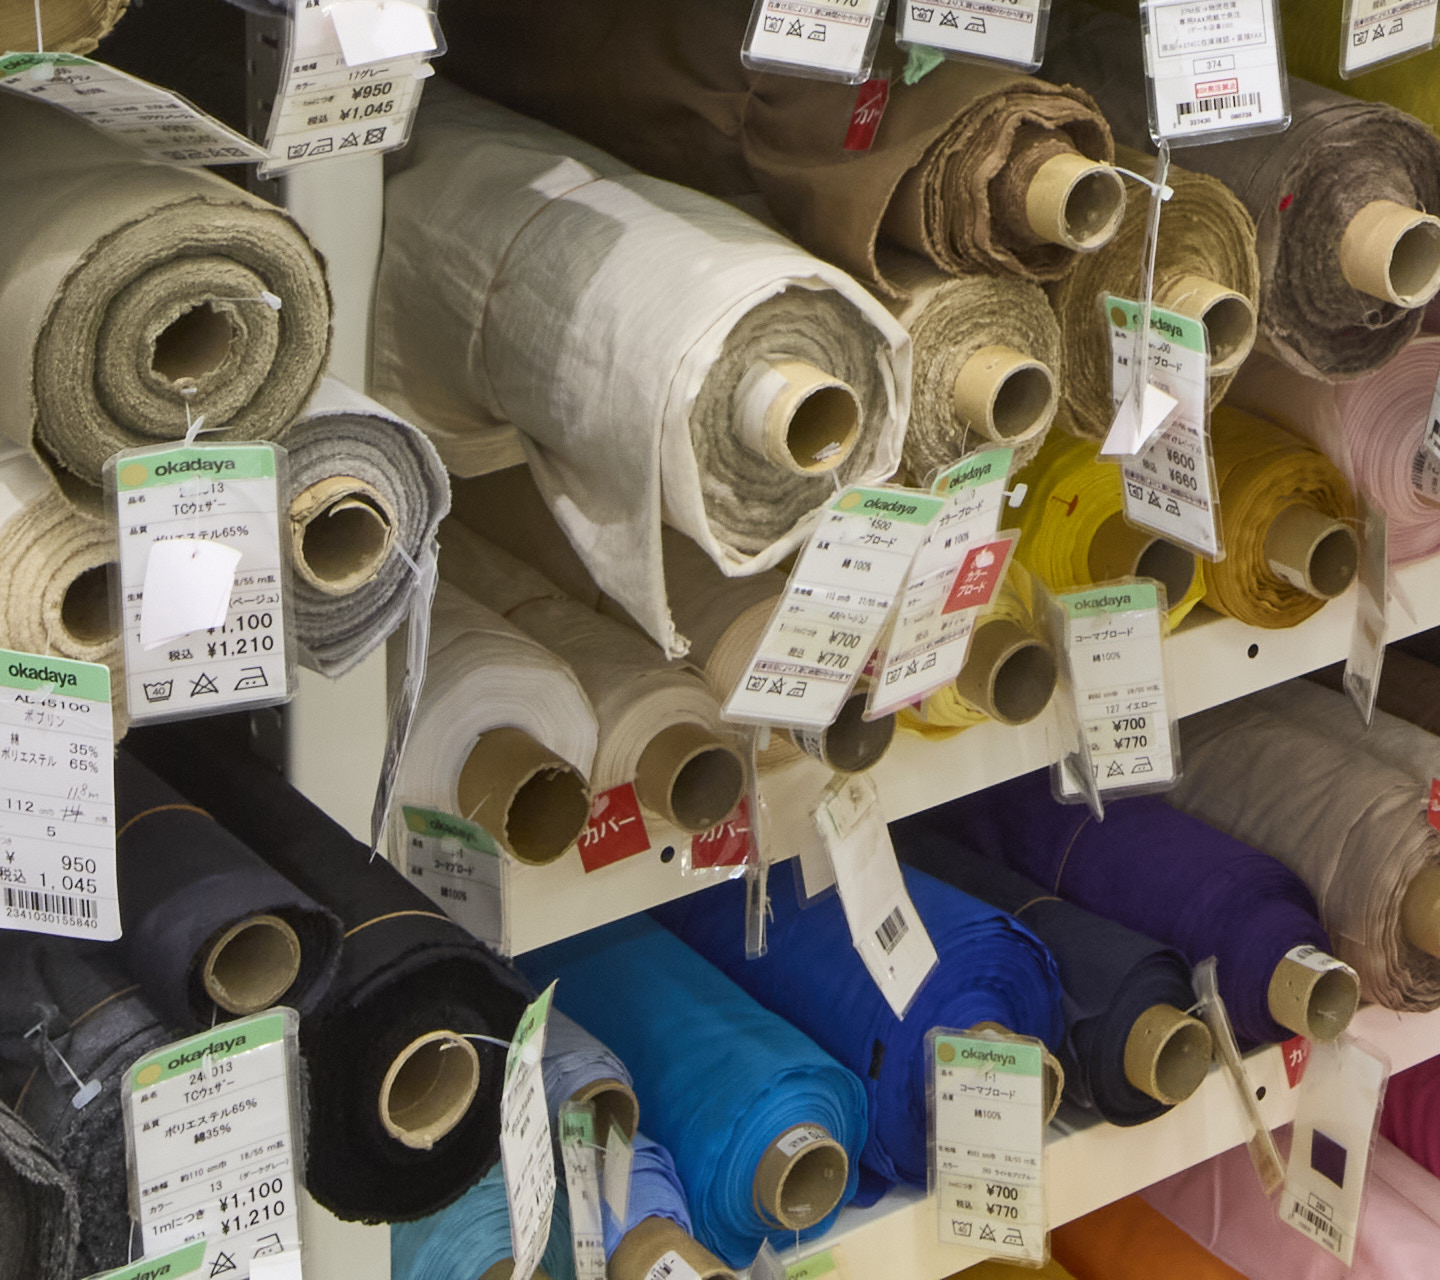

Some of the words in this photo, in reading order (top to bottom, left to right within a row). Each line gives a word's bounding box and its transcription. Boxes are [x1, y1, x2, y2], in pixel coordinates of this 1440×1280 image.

[155, 458, 235, 476] okadaya
[207, 636, 273, 658] ¥1,210
[9, 663, 77, 688] okadaya
[1112, 717, 1145, 732] ¥700
[1114, 735, 1147, 749] ¥770
[579, 812, 631, 847] カバー
[62, 856, 96, 874] 950
[986, 1184, 1018, 1200] ¥700
[220, 1197, 284, 1235] ¥1,210
[987, 1203, 1018, 1219] ¥770
